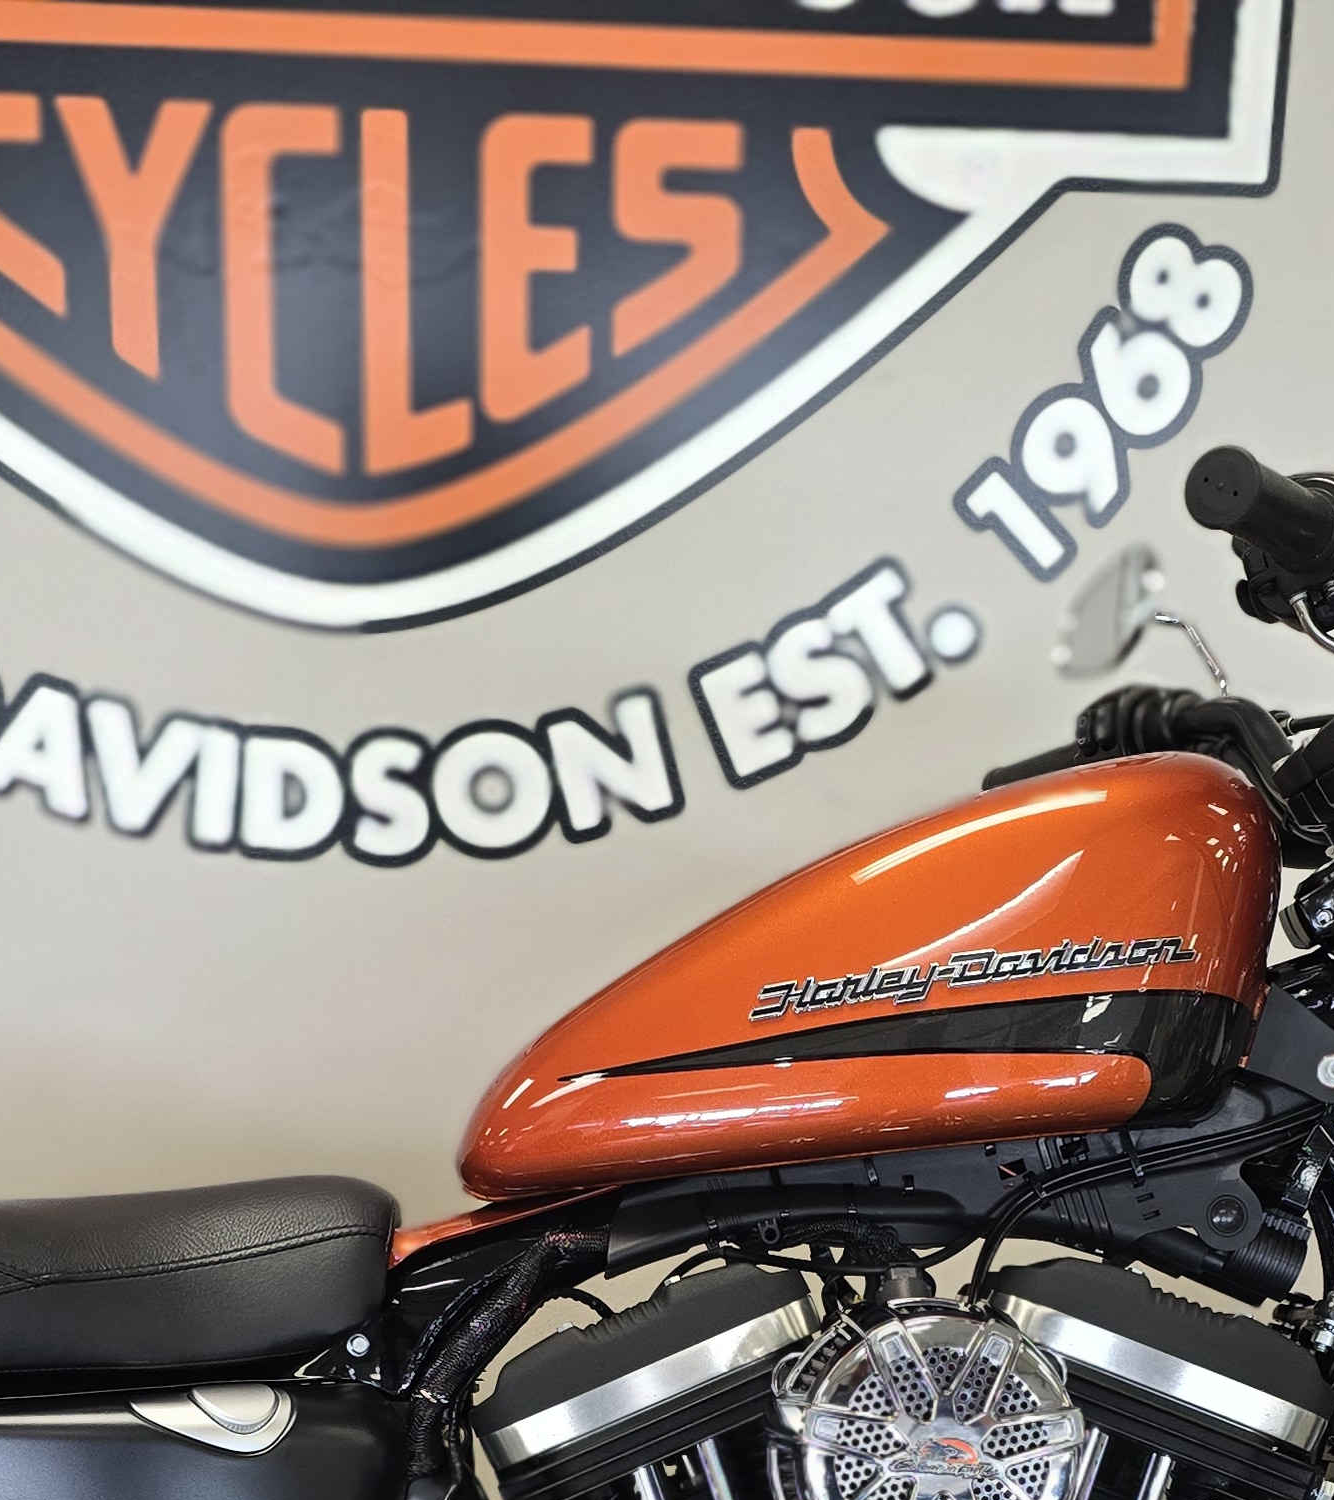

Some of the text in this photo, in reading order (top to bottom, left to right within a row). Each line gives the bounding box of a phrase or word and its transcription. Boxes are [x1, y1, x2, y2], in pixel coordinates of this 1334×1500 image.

[689, 556, 982, 788] EST.
[953, 224, 1253, 580] 1968
[750, 936, 1197, 1022] Harley-Davidson
